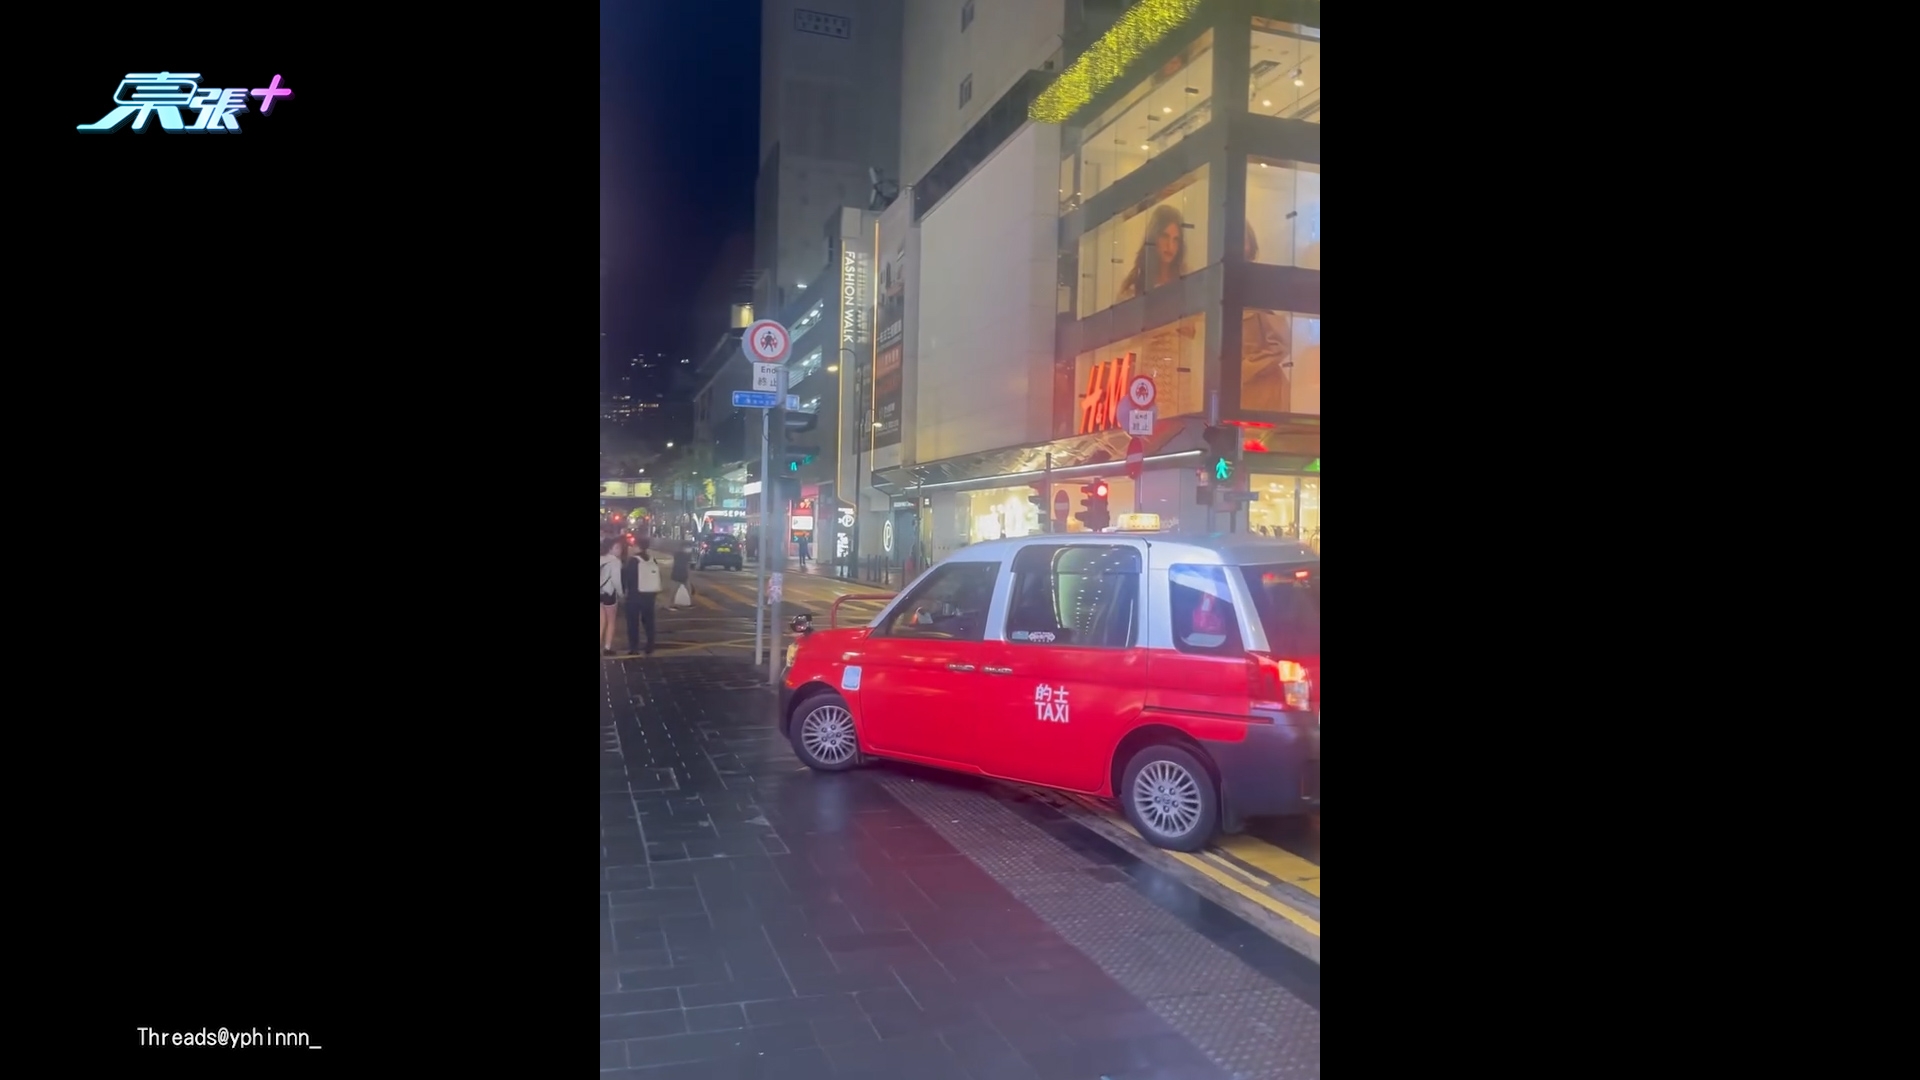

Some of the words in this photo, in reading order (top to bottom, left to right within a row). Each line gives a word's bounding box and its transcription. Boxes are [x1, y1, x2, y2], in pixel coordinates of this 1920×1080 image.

[844, 250, 856, 306] FASHION
[843, 308, 855, 343] WALK
[1079, 351, 1135, 434] H&M
[1035, 683, 1069, 703] 的士
[1034, 701, 1069, 723] TAXI
